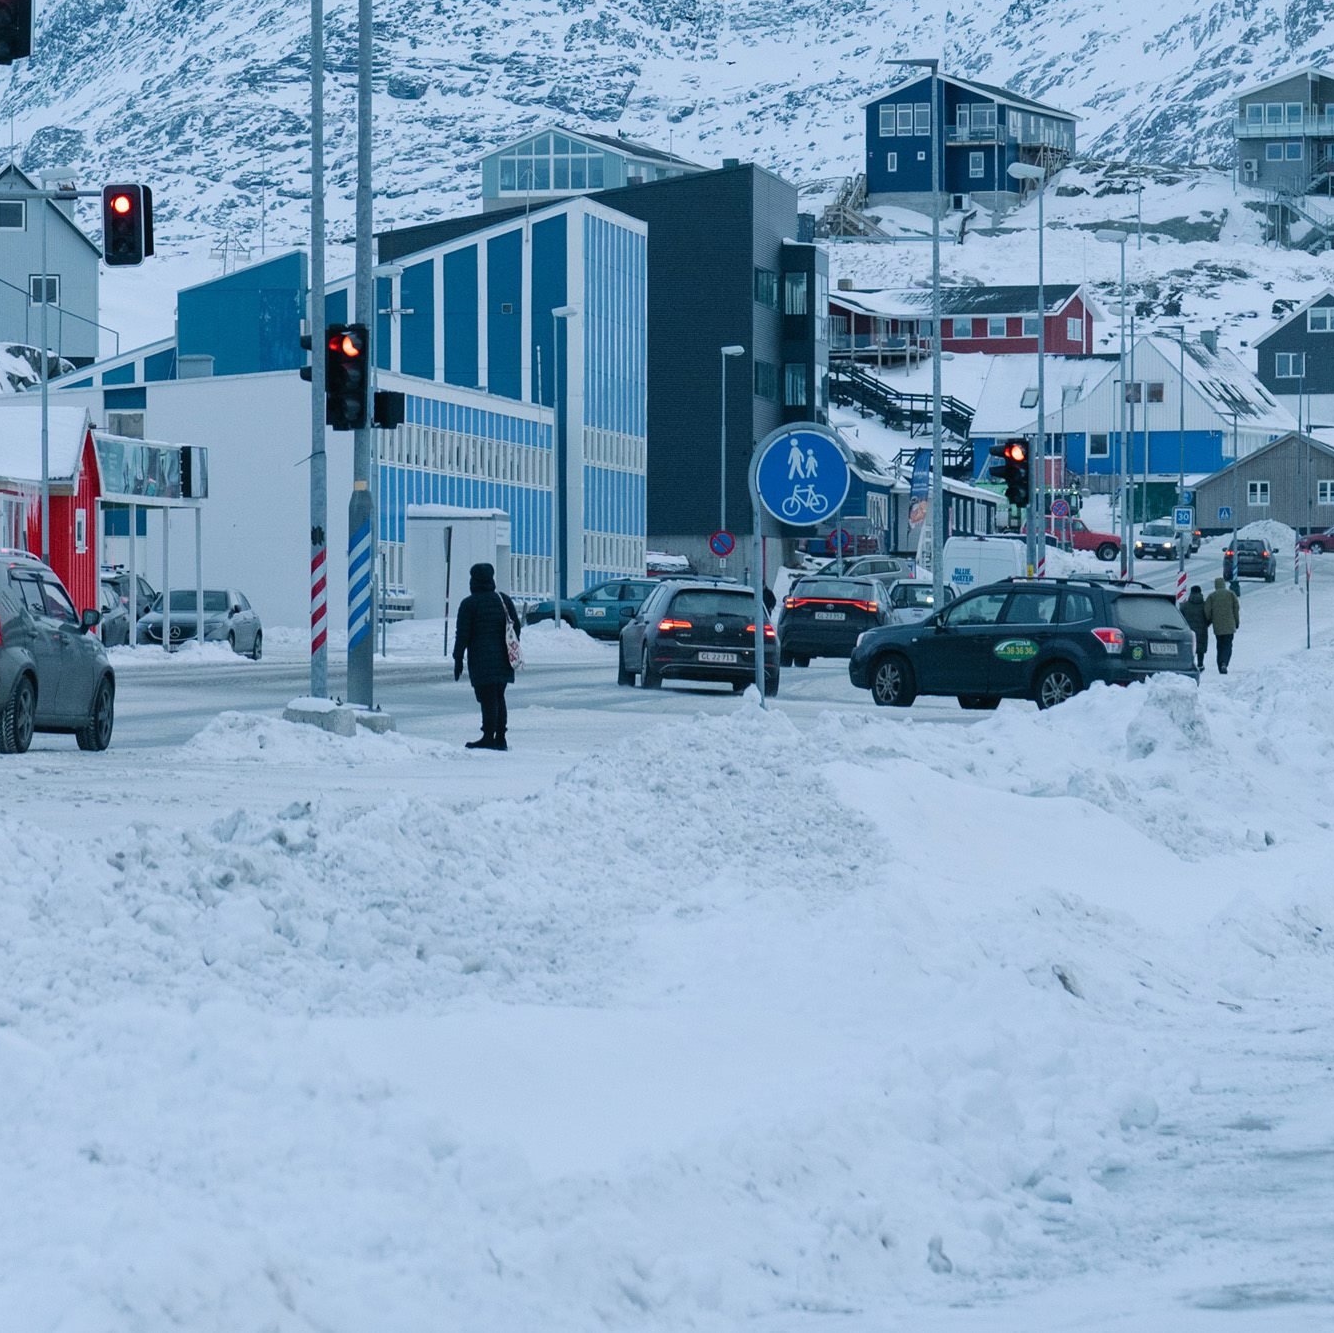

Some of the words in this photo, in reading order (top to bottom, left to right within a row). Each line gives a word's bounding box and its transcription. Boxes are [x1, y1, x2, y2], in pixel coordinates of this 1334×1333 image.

[1177, 512, 1190, 521] 30
[954, 567, 971, 575] BLUE
[951, 574, 974, 582] WATER
